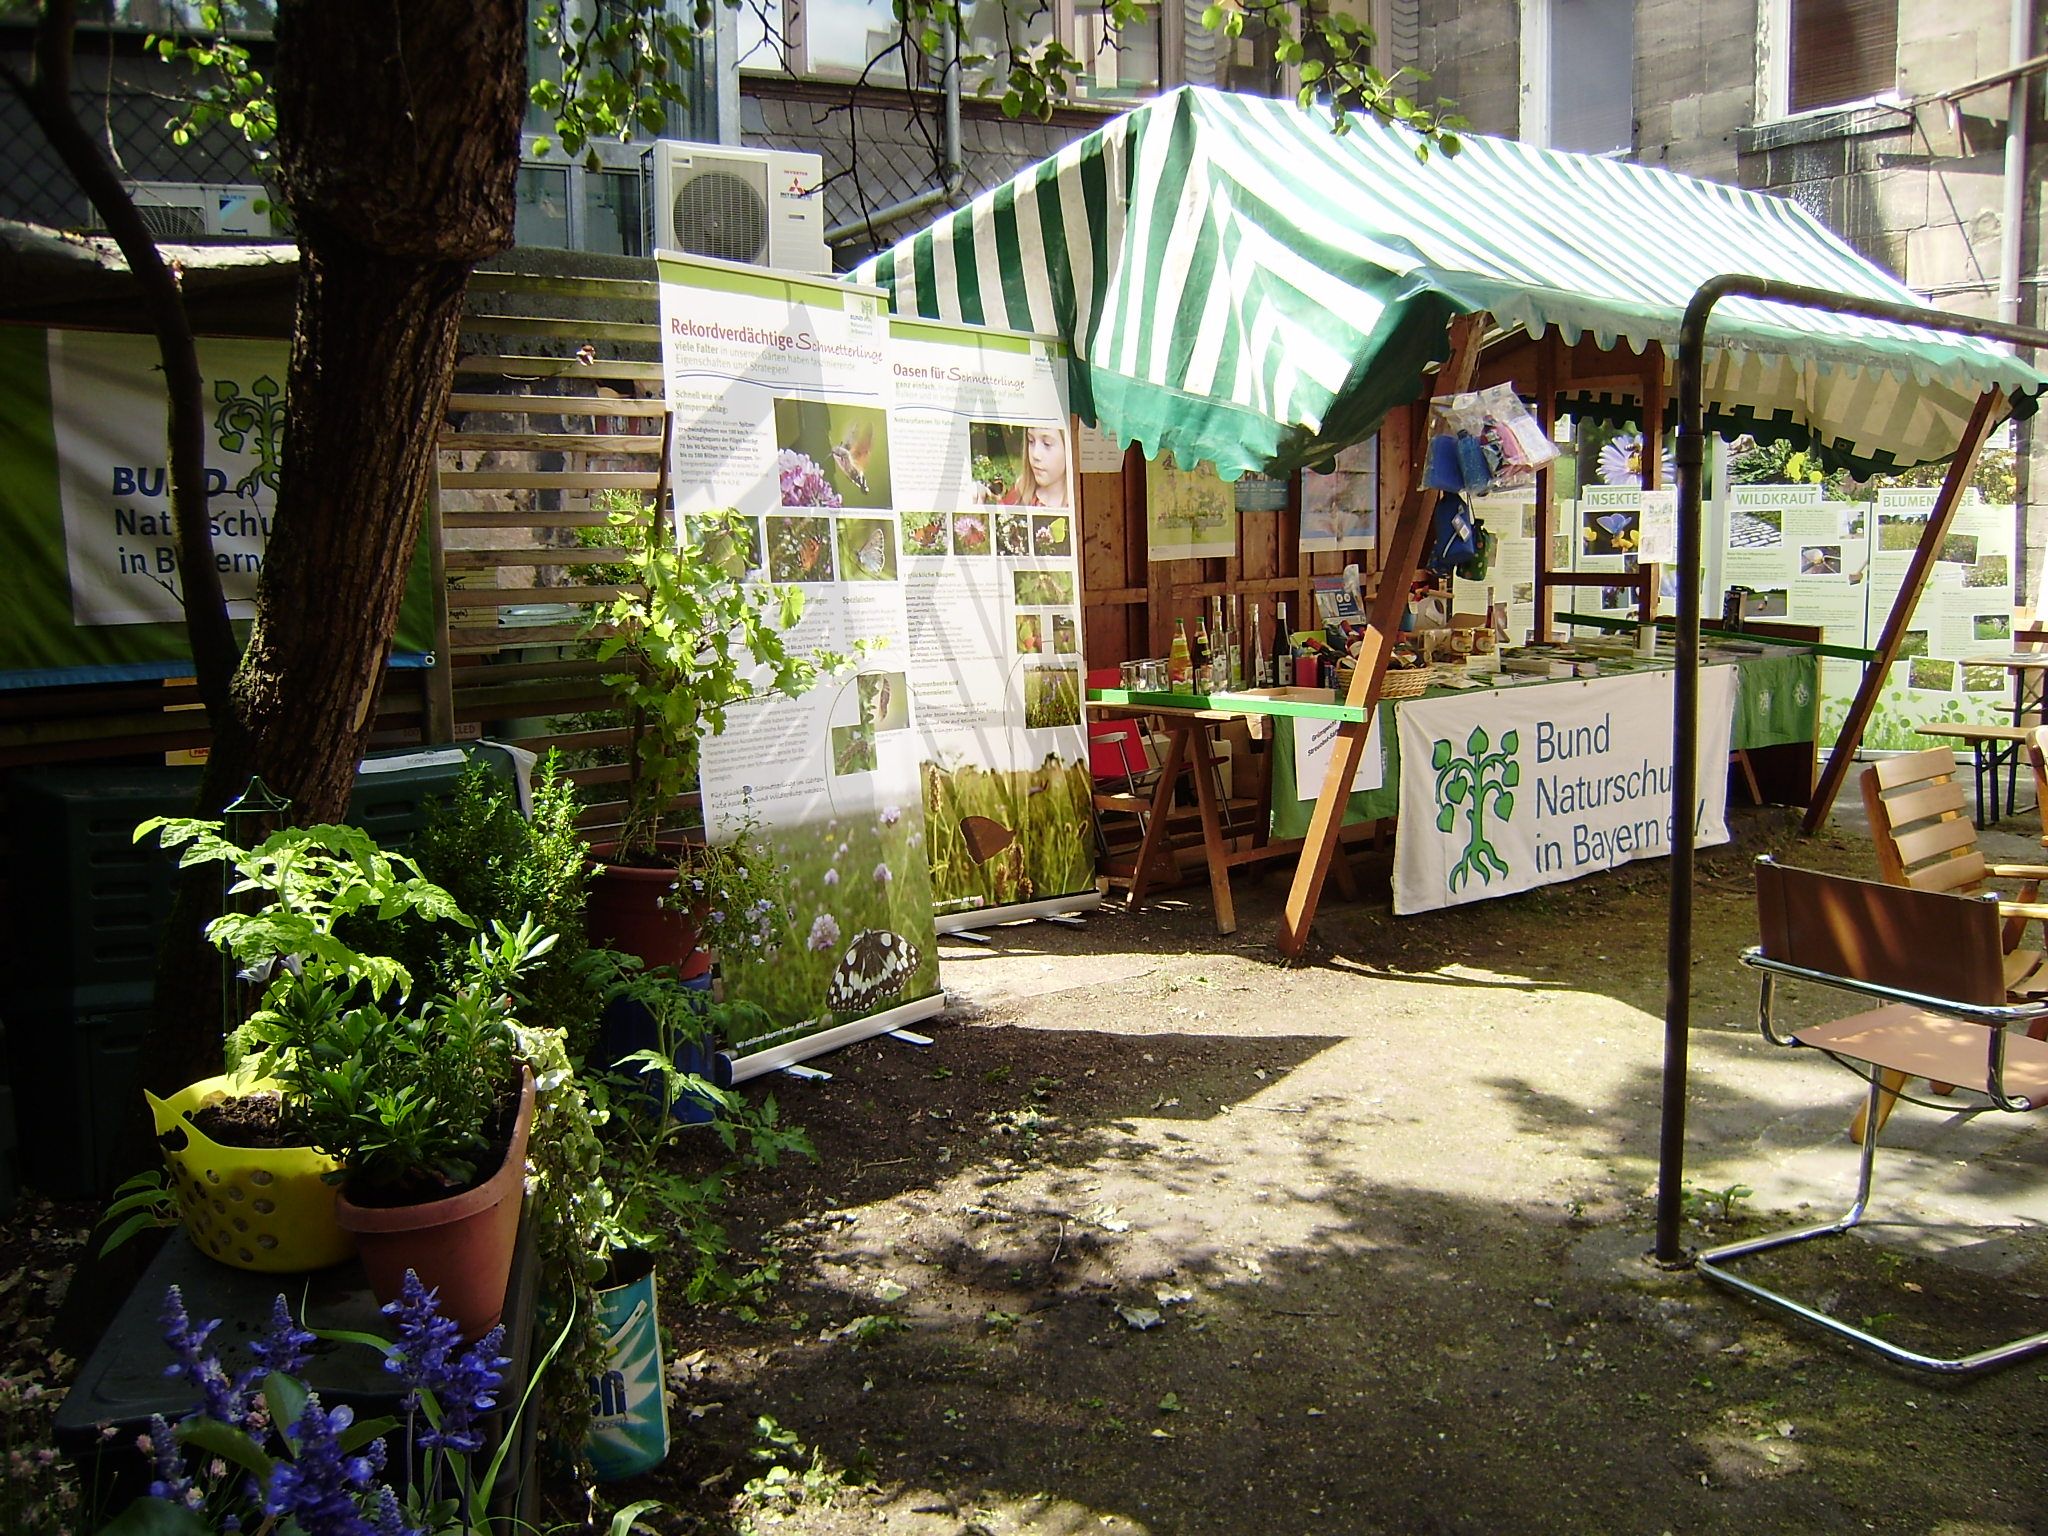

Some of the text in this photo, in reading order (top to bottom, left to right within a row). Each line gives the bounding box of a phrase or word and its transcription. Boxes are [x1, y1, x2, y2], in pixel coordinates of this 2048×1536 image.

[671, 317, 884, 364] Rekordverdächtige Schmetterlinge
[674, 341, 696, 354] viele
[696, 343, 720, 355] Falter
[788, 353, 810, 365] haben
[676, 353, 790, 376] Eigenschaften und Strategien!
[893, 363, 928, 379] Oasen
[931, 365, 945, 380] für
[947, 367, 1025, 391] Schmetterlinge
[674, 389, 700, 400] Schnell
[895, 382, 911, 391] ganz
[112, 466, 228, 498] BUD
[1587, 492, 1641, 506] INSEKTE
[1736, 492, 1816, 505] WILDKRAUT
[1883, 494, 1974, 508] BLUMENSE
[115, 508, 273, 537] Natschu
[119, 546, 261, 575] in Bern
[1536, 712, 1611, 763] Bund
[1536, 759, 1673, 819] Naturschu
[1535, 832, 1563, 874] in
[1573, 817, 1660, 867] Bayern
